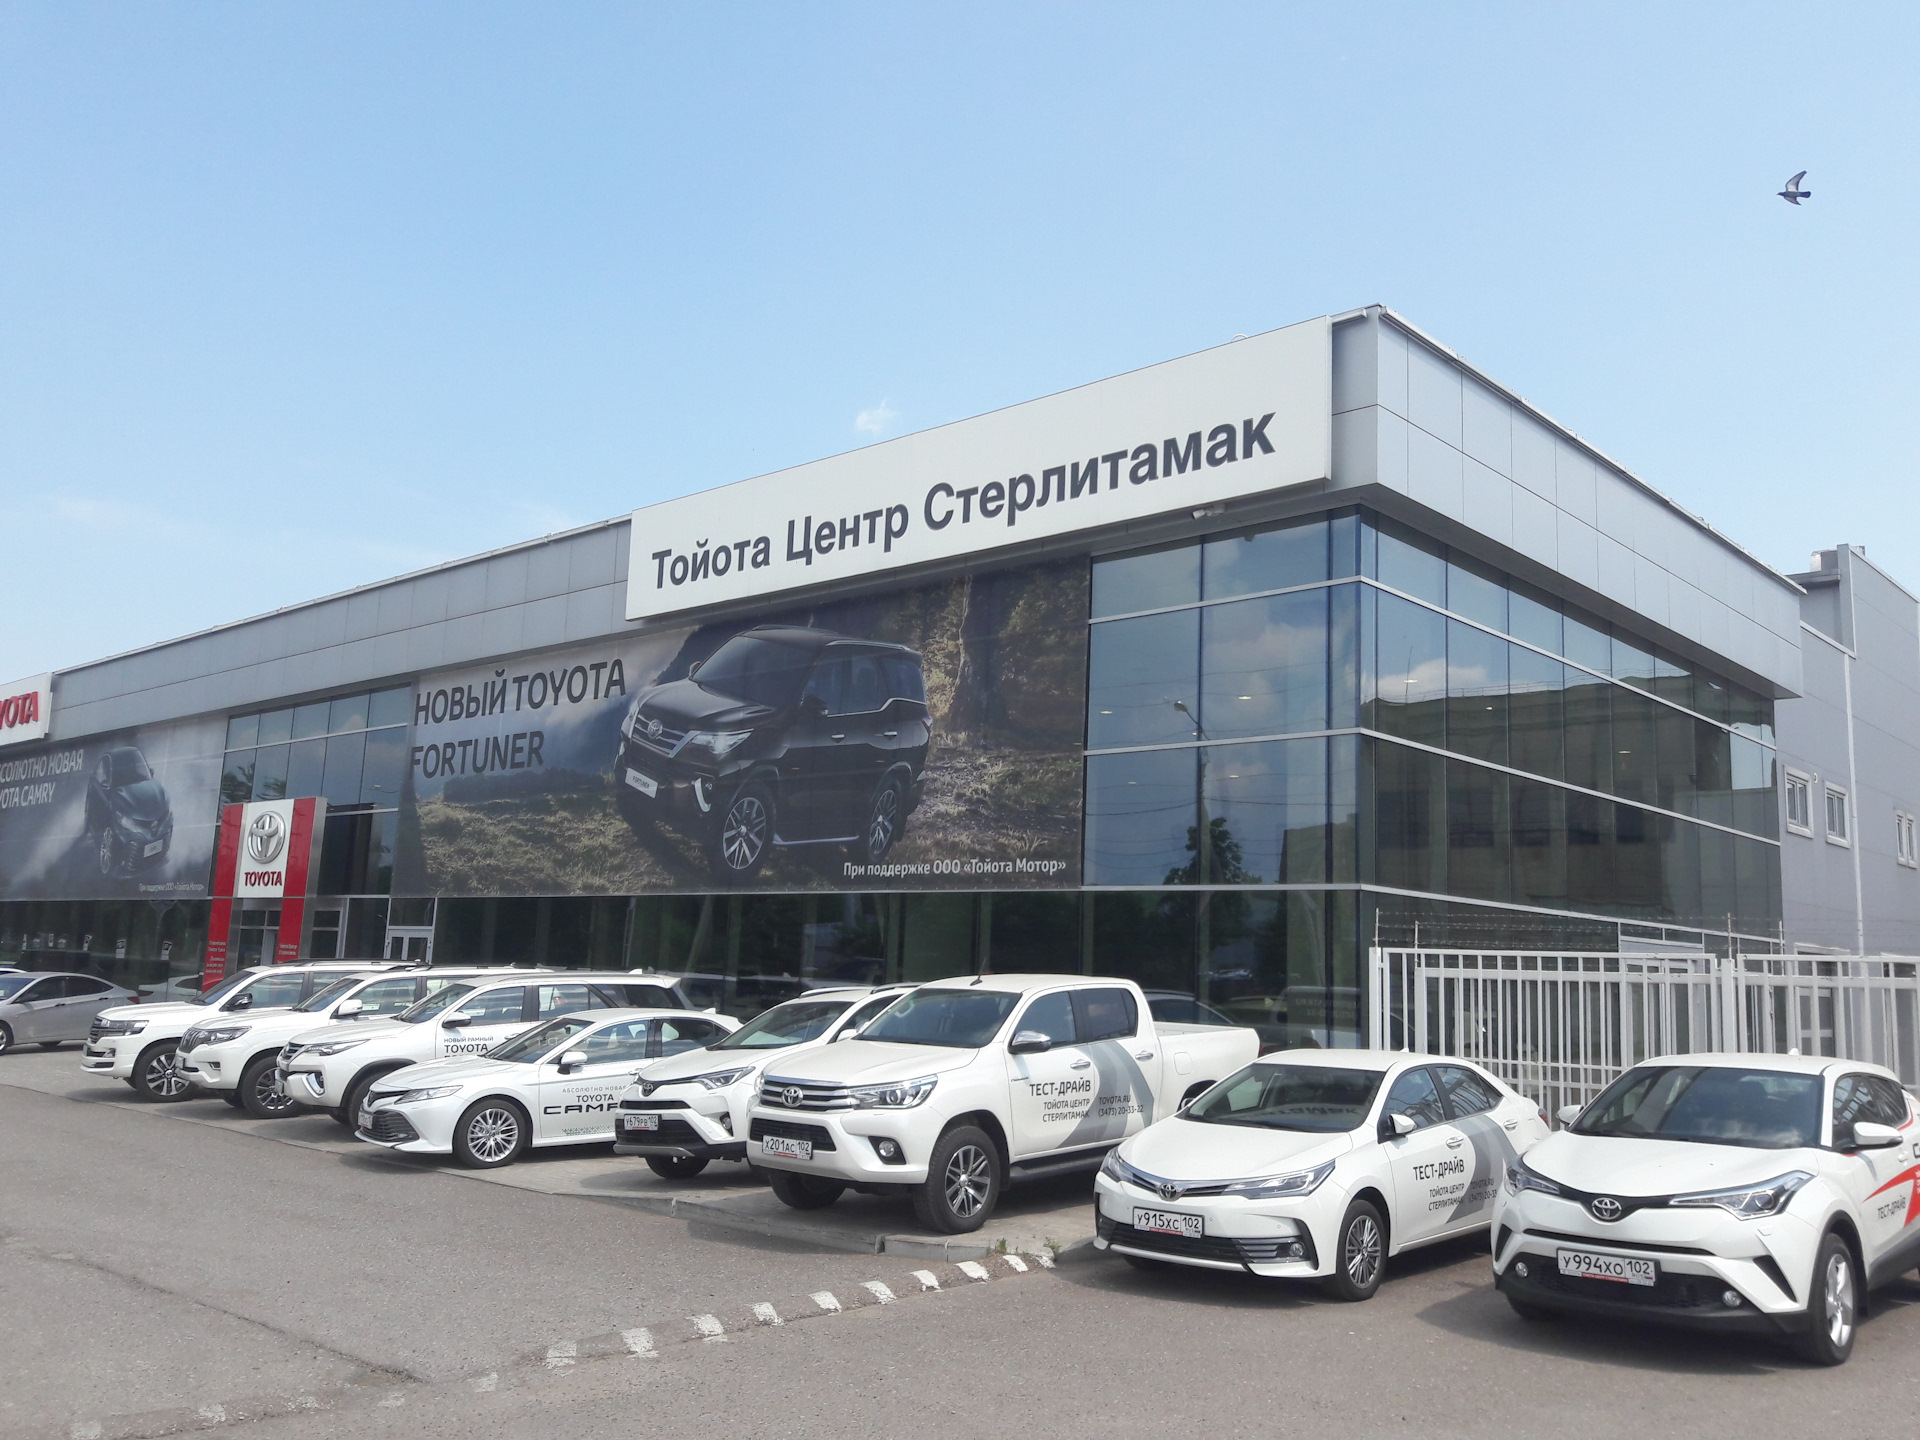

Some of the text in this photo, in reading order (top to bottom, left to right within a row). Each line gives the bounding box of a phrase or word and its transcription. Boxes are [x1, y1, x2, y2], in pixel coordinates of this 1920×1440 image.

[652, 412, 1276, 589] Тойота Центр Стерлитамак
[414, 659, 626, 726] НОВЫЙ TOYOTA
[0, 691, 39, 730] YOTA
[410, 731, 545, 779] FORTUNER
[0, 749, 84, 784] СОЛЮТНО НОВАЯ
[21, 782, 56, 807] CAMRY
[843, 857, 1067, 879] При поддержке ООО «Тойота Мотор»
[244, 871, 283, 887] TOYOTA
[444, 1043, 488, 1053] TOYOTA
[562, 1086, 603, 1094] АБСОЛЮТНО
[1029, 1077, 1091, 1096] ТЕСТ-ДРАЙВ
[576, 1094, 614, 1103] TOYOTA
[1043, 1098, 1090, 1110] ТОЙОТА ЦЕНТР
[1099, 1094, 1131, 1105] TOYOTA.RU
[544, 1102, 618, 1115] CAMR
[1042, 1109, 1090, 1122] СТЕРЛИТАМАК
[1098, 1105, 1144, 1118] (3473) 20-33-22
[765, 1138, 809, 1153] Х201АС 102
[1413, 1156, 1465, 1180] ТЕСТ-ДРАЙВ
[1429, 1183, 1465, 1198] ТОЙОТА ЦЕНТР
[1484, 1189, 1498, 1200] 20-33
[1428, 1196, 1464, 1212] СТЕРЛИТАМАК
[1137, 1212, 1200, 1230] У915ХС 102
[1563, 1254, 1624, 1275] У994ХО
[1627, 1260, 1650, 1275] 102
